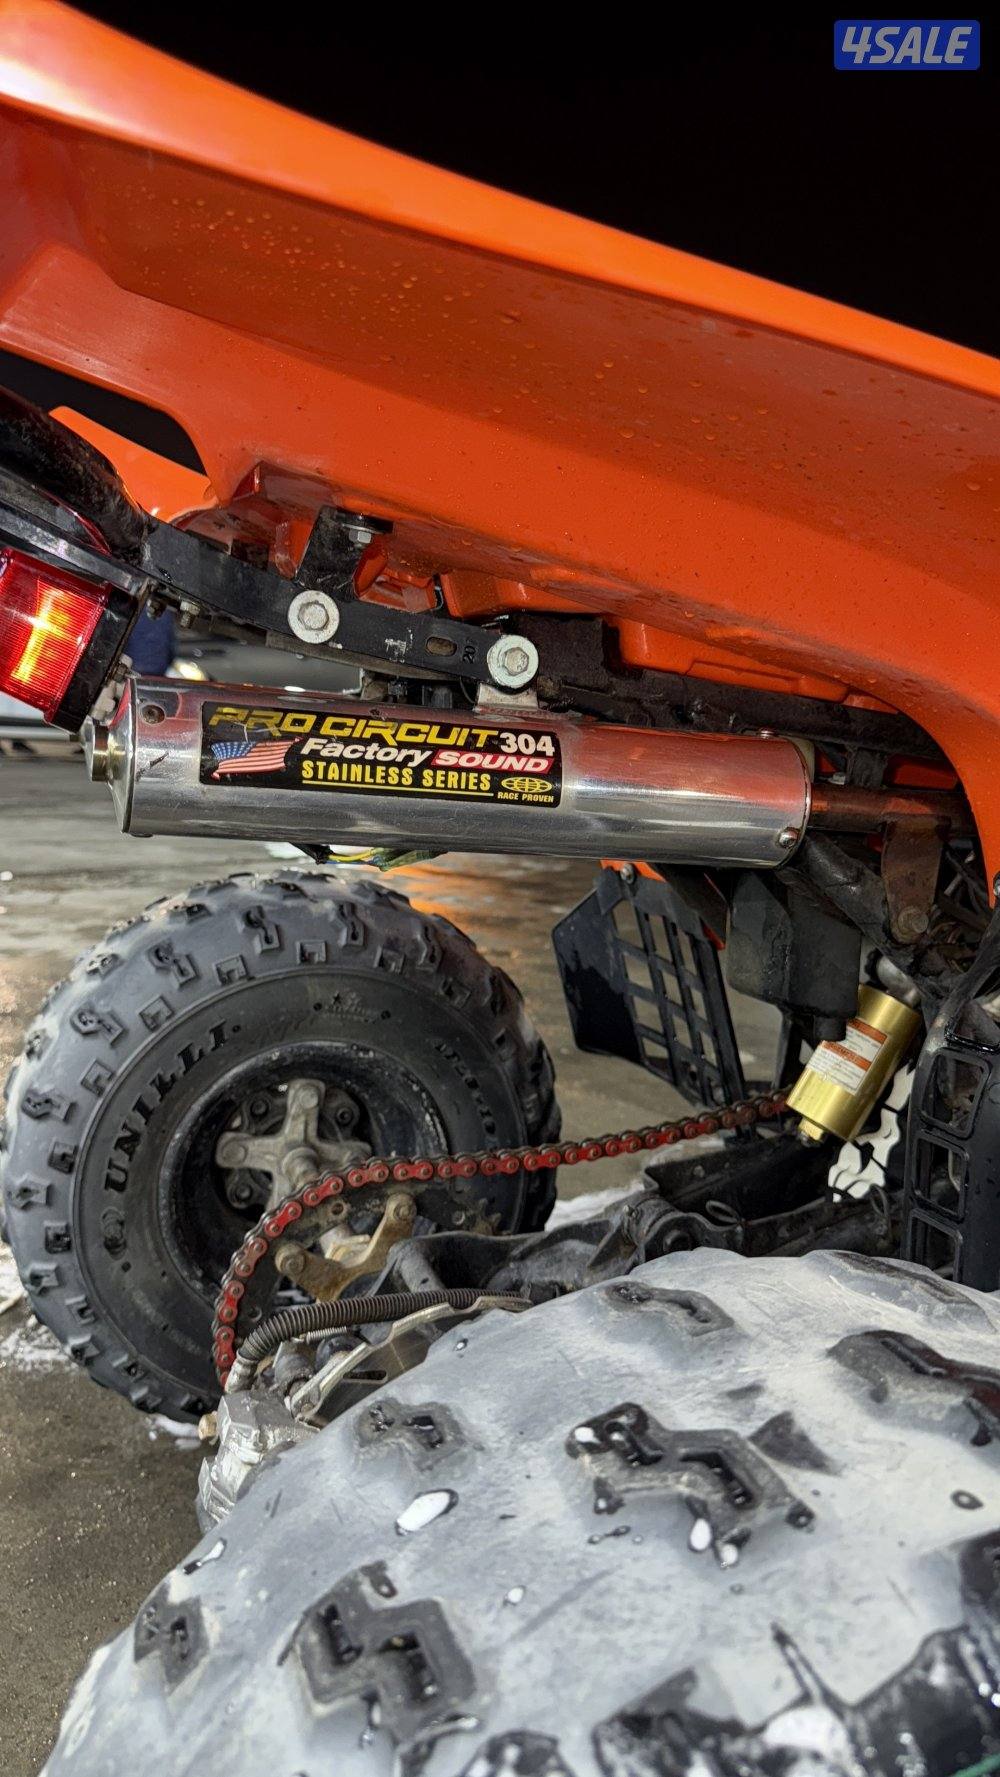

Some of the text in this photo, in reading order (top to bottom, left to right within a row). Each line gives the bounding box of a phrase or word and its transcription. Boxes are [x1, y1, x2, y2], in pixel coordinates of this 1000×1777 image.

[208, 706, 555, 756] PRO CIRCUIT 304
[301, 737, 549, 772] Factory SOUND
[301, 760, 491, 791] STAINLESS SERIES
[497, 791, 554, 803] RACE PROVEN
